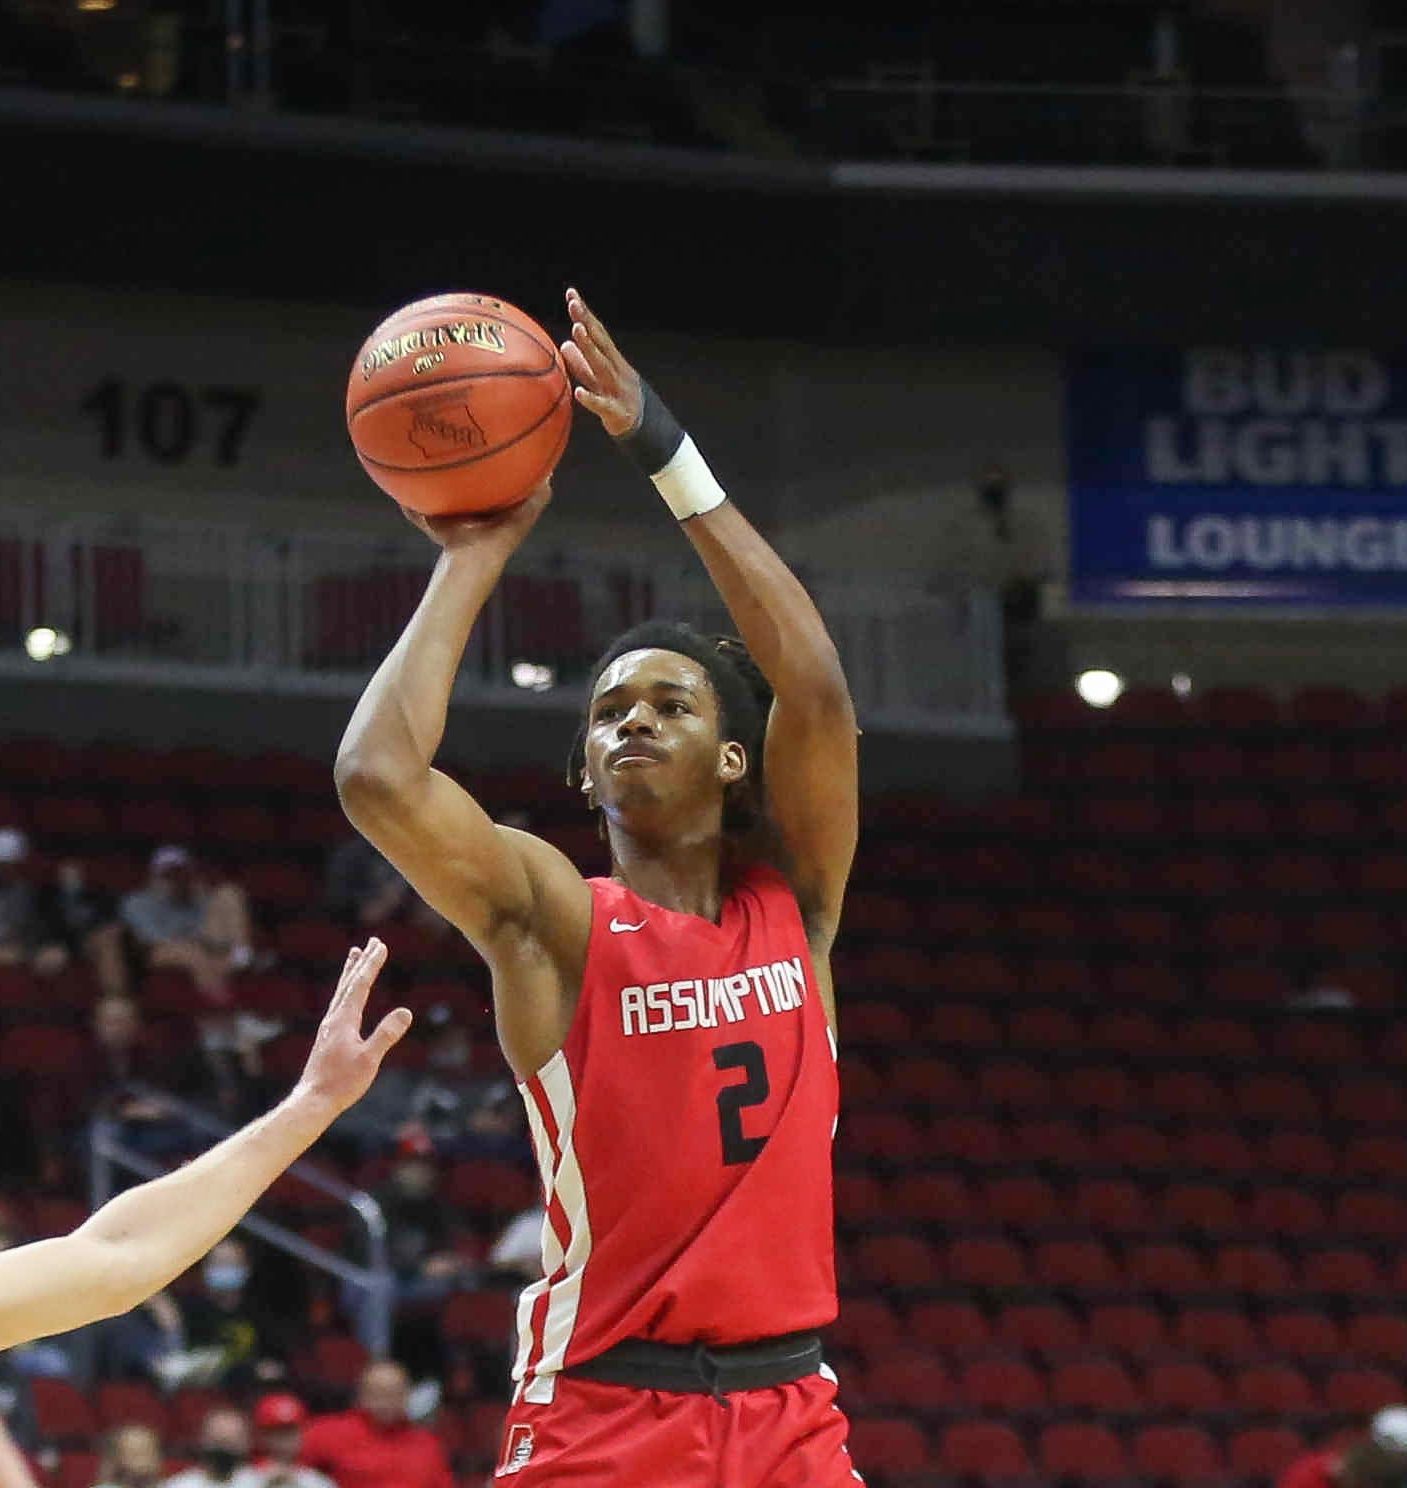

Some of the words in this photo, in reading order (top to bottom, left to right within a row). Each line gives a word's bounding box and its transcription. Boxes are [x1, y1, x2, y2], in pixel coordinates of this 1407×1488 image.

[81, 372, 262, 464] 107
[1185, 352, 1390, 412] BUD
[620, 956, 808, 1036] ASSUMPTION
[712, 1040, 771, 1168] 2
